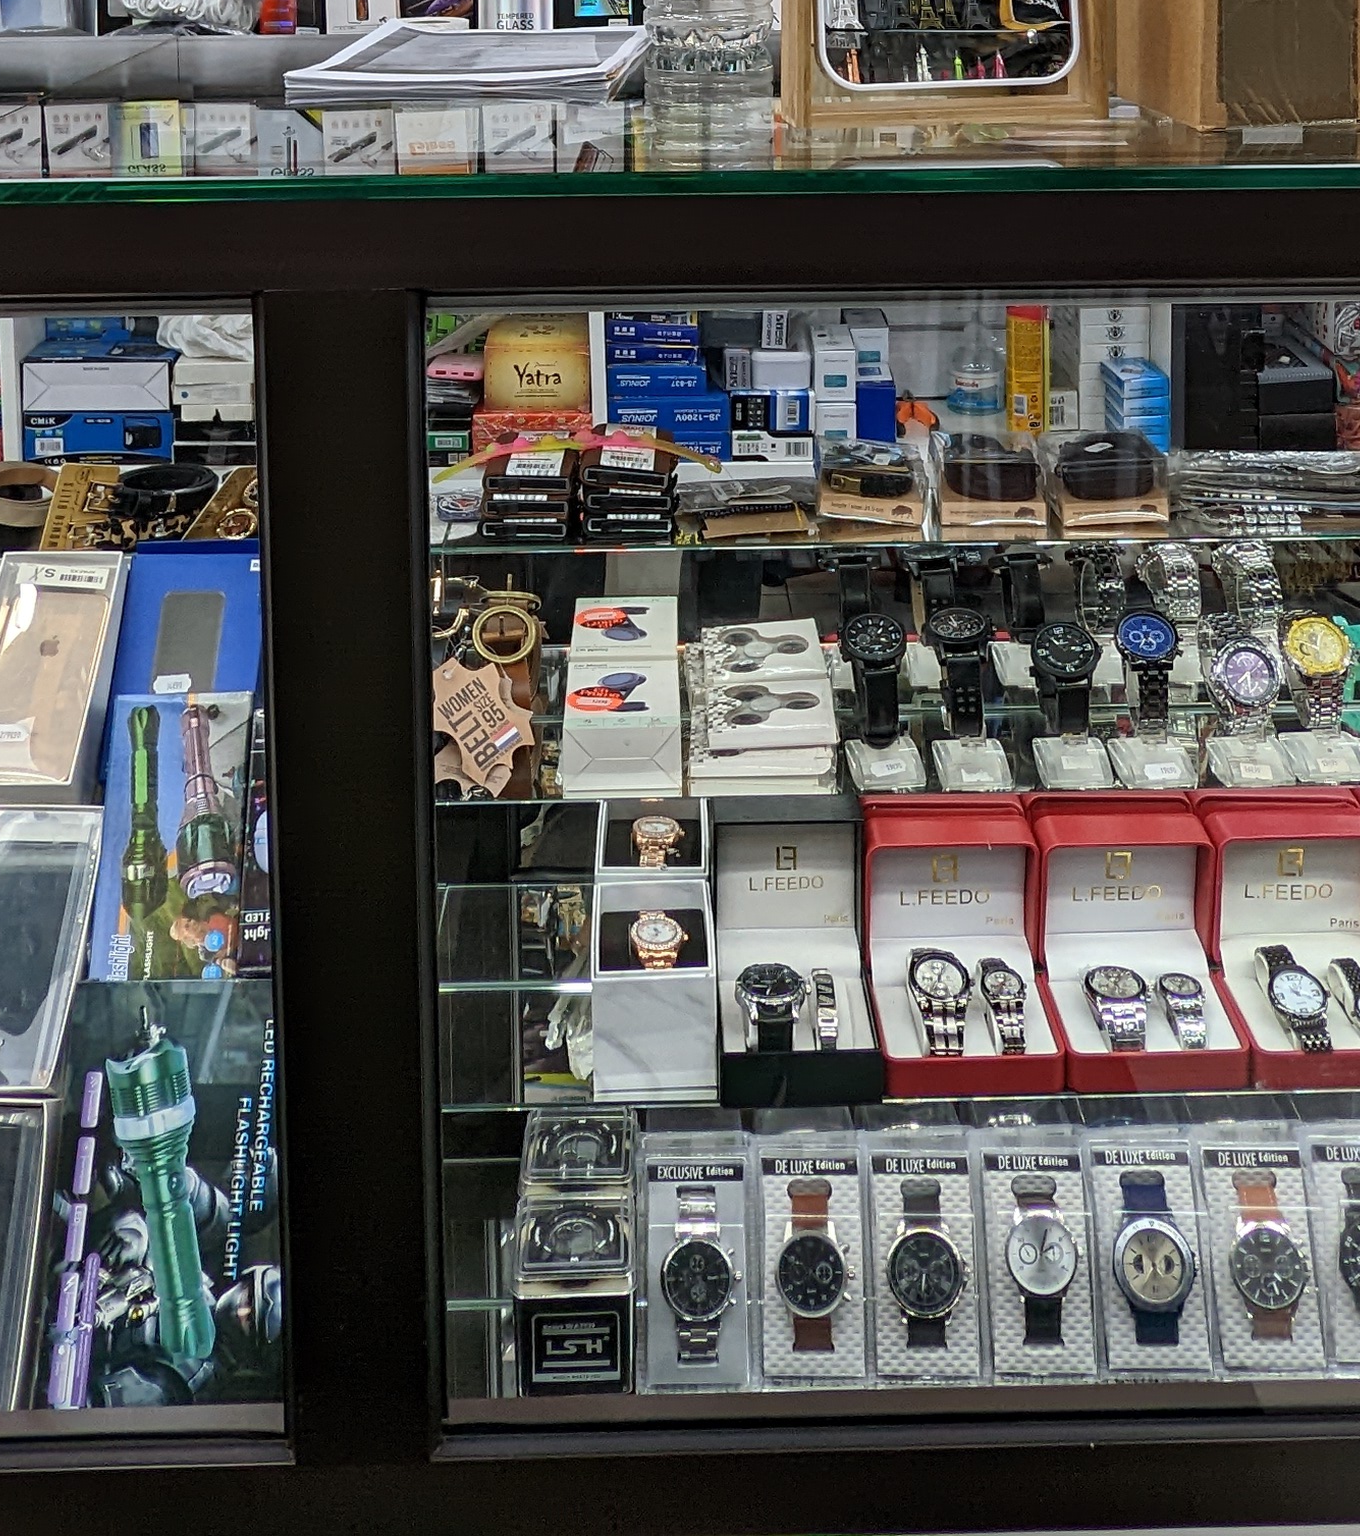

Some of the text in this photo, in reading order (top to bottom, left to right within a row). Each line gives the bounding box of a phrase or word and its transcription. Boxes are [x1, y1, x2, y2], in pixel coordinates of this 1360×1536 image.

[495, 19, 536, 31] GLASS
[512, 361, 563, 388] Yatra
[621, 412, 722, 423] JOINUS JS-1200V
[749, 875, 825, 892] L.FEEDO
[899, 887, 991, 906] L.FEEDO
[1071, 884, 1163, 902] L.FEEDO
[1243, 883, 1334, 901] L.FEEDO
[985, 915, 1015, 926] Paris
[1329, 917, 1360, 929] Paris
[248, 1017, 275, 1213] LED RECHARGEABLE
[1104, 1149, 1177, 1164] DE LUXE Edition
[1217, 1151, 1290, 1167] DE LUXE Edition
[1325, 1146, 1340, 1162] DE
[774, 1159, 847, 1175] DE LUXE Edition
[884, 1157, 957, 1175] DE LUXE Edition
[997, 1156, 1070, 1171] DE LUXE Edition
[656, 1165, 735, 1181] EXCLUSIVE Edition
[221, 1096, 252, 1282] FLASHLIGHT LIGHT
